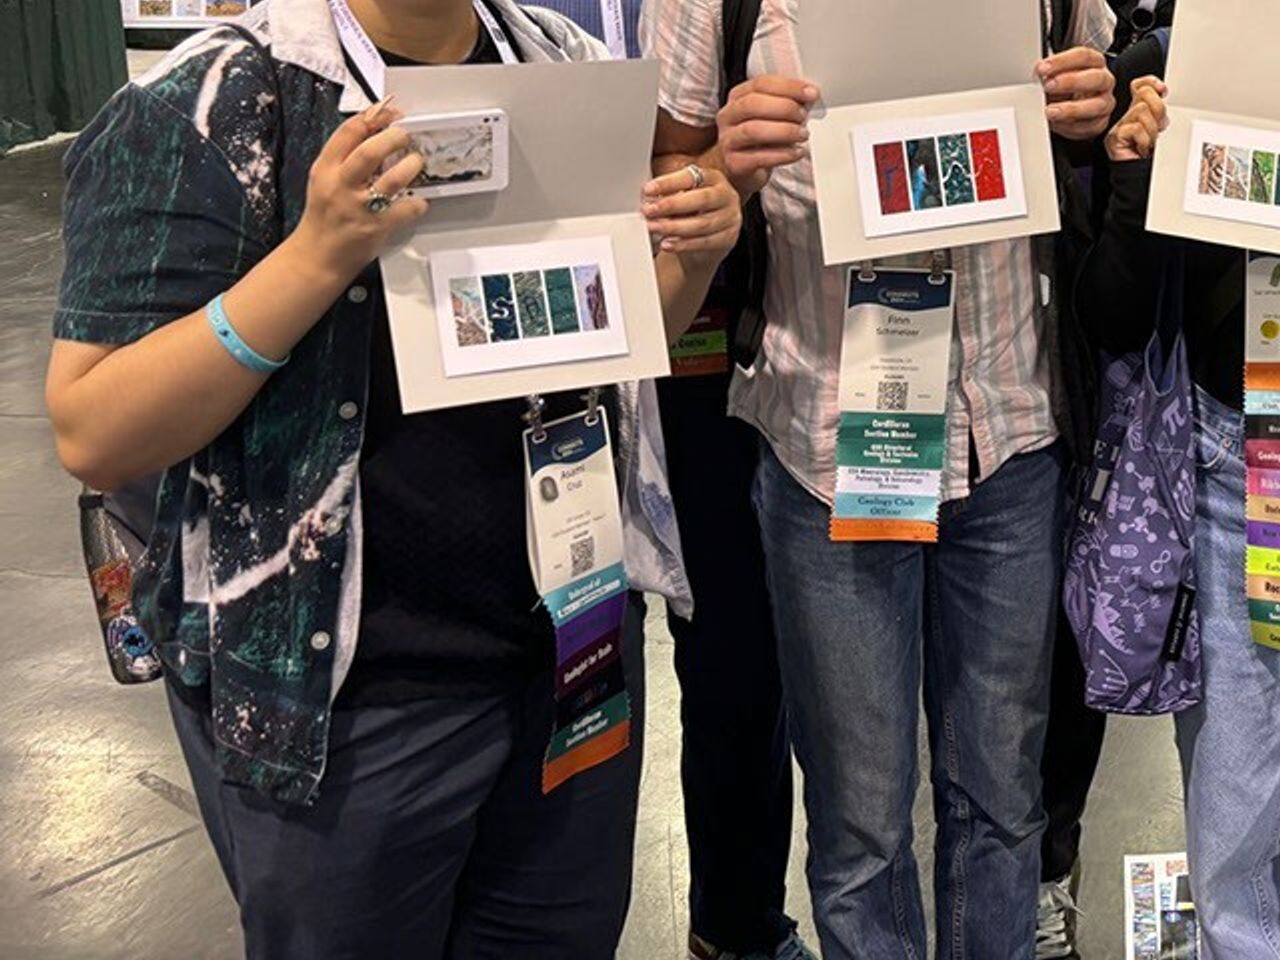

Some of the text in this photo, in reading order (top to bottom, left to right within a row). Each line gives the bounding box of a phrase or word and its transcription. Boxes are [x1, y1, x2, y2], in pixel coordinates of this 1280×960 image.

[888, 315, 911, 325] Finn
[858, 496, 915, 507] Geology Club
